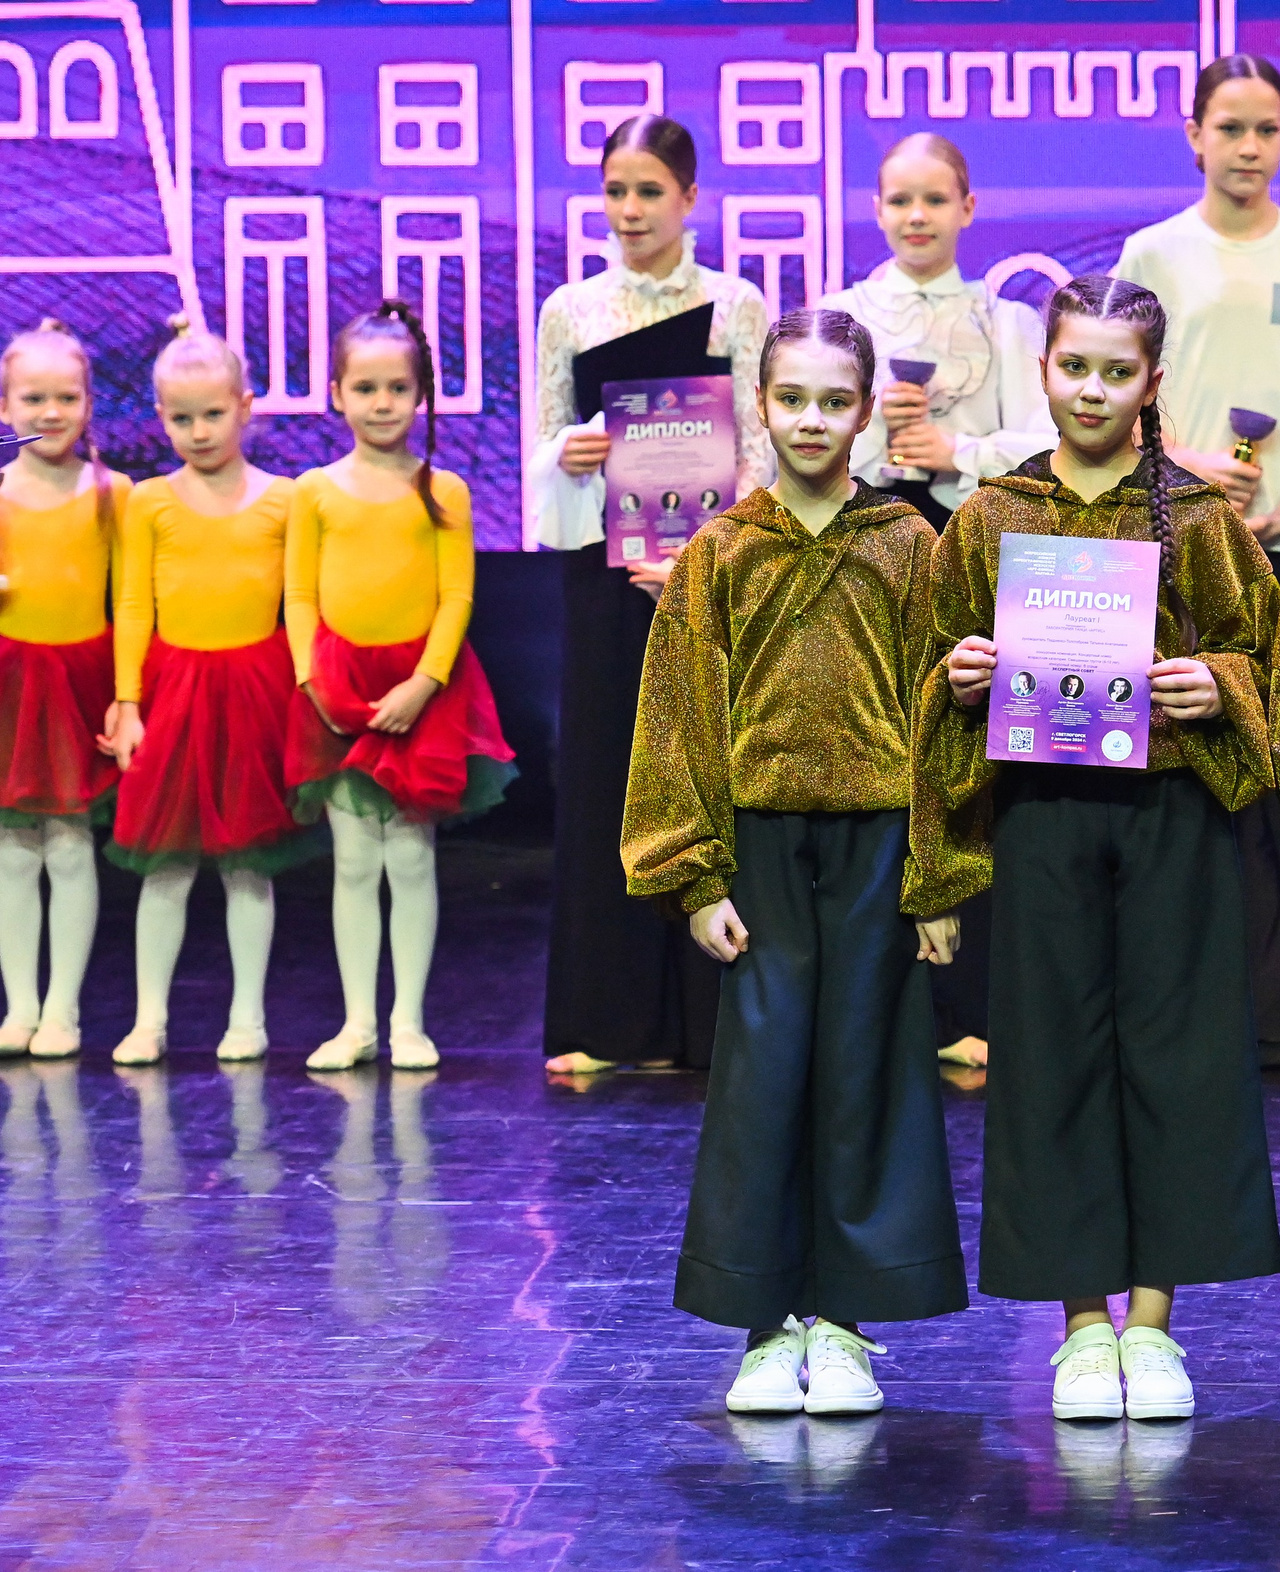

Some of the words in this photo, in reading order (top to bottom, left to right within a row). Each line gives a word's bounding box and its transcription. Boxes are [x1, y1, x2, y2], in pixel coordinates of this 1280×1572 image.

[624, 420, 713, 441] ДИПЛОМ
[1024, 588, 1131, 611] ДИПЛОМ
[1065, 613, 1096, 623] Лауреат
